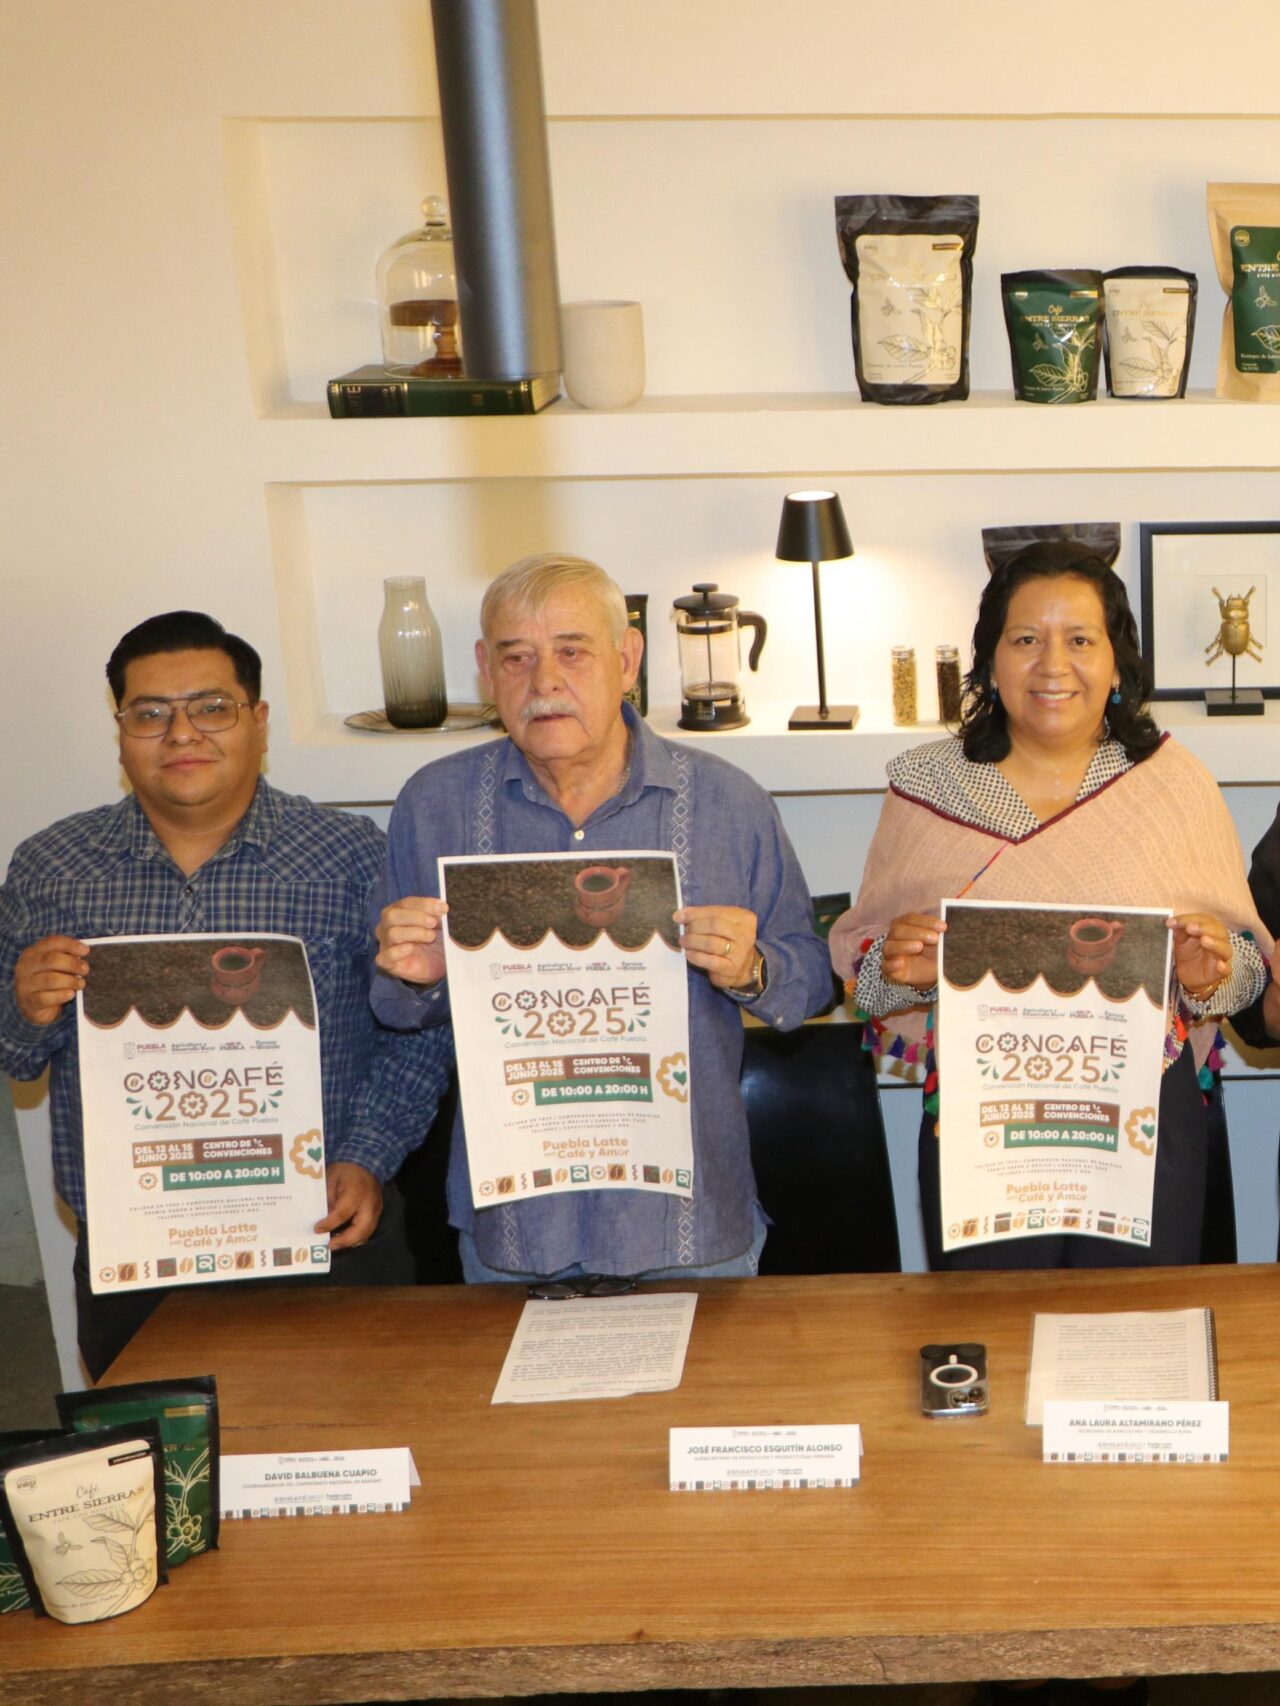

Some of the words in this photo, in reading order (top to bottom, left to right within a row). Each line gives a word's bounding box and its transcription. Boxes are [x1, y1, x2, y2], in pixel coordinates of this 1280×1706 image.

[1240, 264, 1278, 272] ENTRE
[492, 982, 652, 1012] CONCAFÉ
[523, 1007, 627, 1039] 2025
[975, 1032, 1128, 1058] CONCAFÉ
[573, 1058, 607, 1066] CENTRO
[1002, 1053, 1101, 1083] 2025
[573, 1065, 641, 1074] CONVENCIONES
[124, 1061, 284, 1093] CONCAFÉ
[541, 1088, 558, 1098] DE
[559, 1086, 592, 1096] 10:00
[595, 1085, 603, 1094] A
[605, 1084, 639, 1094] 20:00
[640, 1086, 648, 1095] H
[155, 1088, 259, 1121] 2025
[1044, 1112, 1110, 1122] CONVENCIONES
[543, 1138, 590, 1151] Puebla
[593, 1136, 629, 1147] Latte
[1011, 1131, 1025, 1140] DE
[1028, 1130, 1059, 1139] 10:00
[1061, 1131, 1070, 1139] A
[1072, 1131, 1104, 1141] 20:00
[1106, 1135, 1114, 1144] H
[203, 1140, 238, 1150] CENTRO
[240, 1140, 251, 1148] DE
[203, 1148, 272, 1158] CONVENCIONES
[558, 1149, 586, 1159] Café
[589, 1150, 595, 1159] y
[599, 1148, 629, 1158] Amor
[170, 1172, 186, 1183] DE
[189, 1170, 222, 1181] 10:00
[224, 1169, 233, 1179] A
[235, 1168, 269, 1177] 20:00
[271, 1167, 280, 1177] H
[1006, 1182, 1050, 1194] Puebla
[1053, 1181, 1087, 1192] Latte
[1019, 1193, 1046, 1202] Café
[1048, 1194, 1054, 1203] y
[1057, 1192, 1087, 1201] Amor
[169, 1224, 218, 1239] Puebla
[221, 1222, 257, 1234] Latte
[184, 1235, 212, 1248] Café
[216, 1237, 222, 1246] y
[225, 1233, 257, 1244] Amor
[1069, 1419, 1087, 1427] ANA
[1089, 1419, 1117, 1427] LAURA
[1119, 1419, 1174, 1427] ALTAMIRANO
[1176, 1418, 1201, 1427] PÉREZ
[687, 1445, 710, 1455] JOSÉ
[712, 1445, 762, 1453] FRANCISCO
[764, 1443, 804, 1453] ESQUITÍN
[806, 1444, 842, 1452] ALONSO
[265, 1472, 293, 1481] DAVID
[295, 1470, 340, 1479] BALBUENA
[343, 1469, 377, 1477] CUAPIO
[76, 1483, 99, 1499] Café
[28, 1501, 80, 1523] ENTRE
[83, 1485, 145, 1509] SIERRAS
